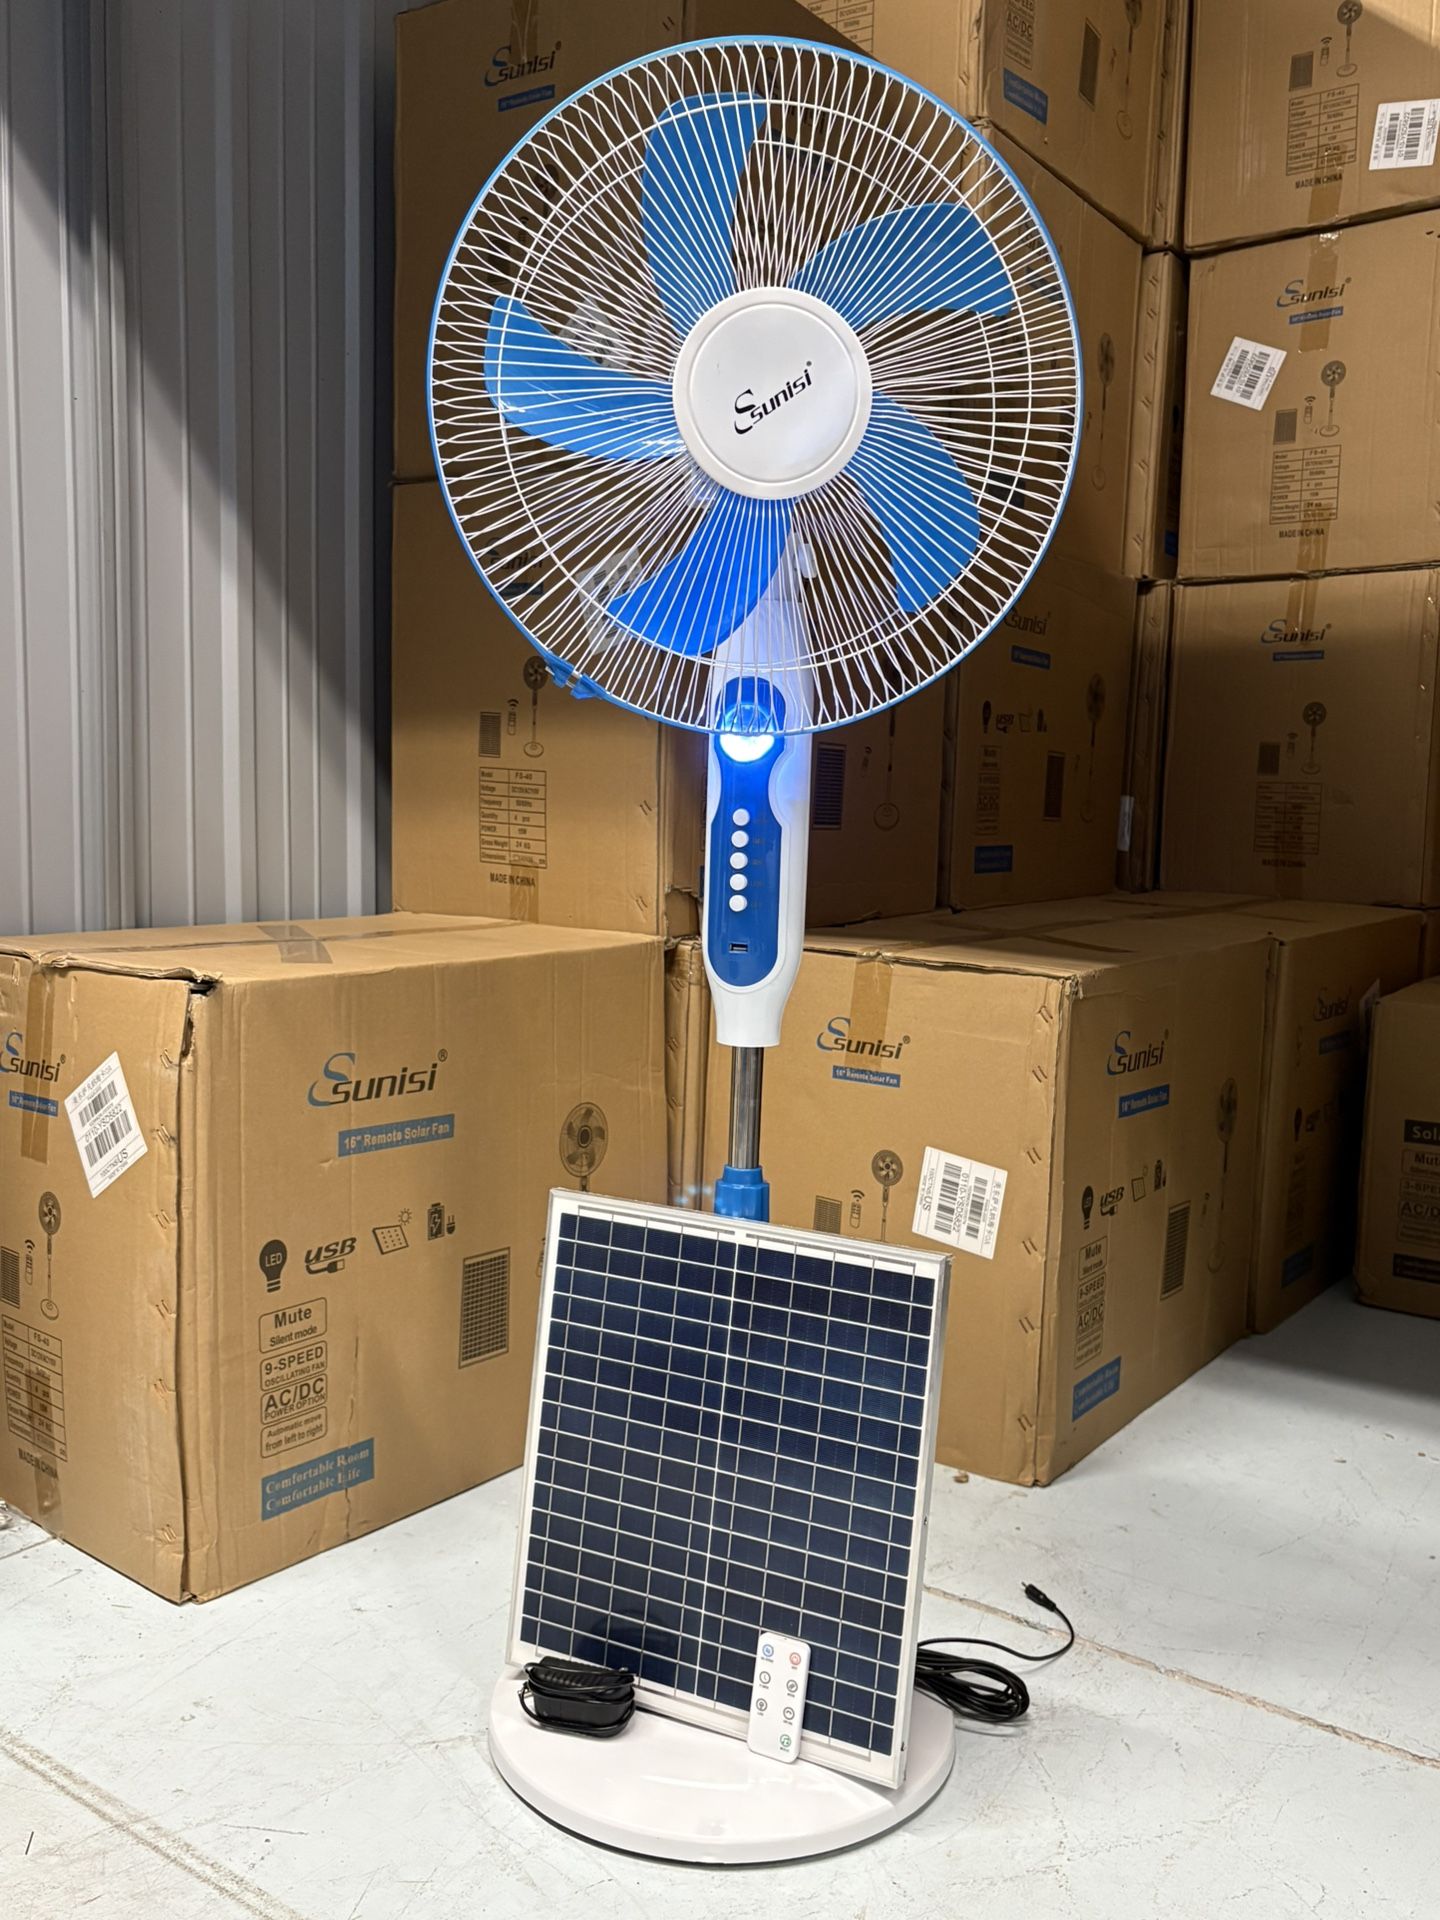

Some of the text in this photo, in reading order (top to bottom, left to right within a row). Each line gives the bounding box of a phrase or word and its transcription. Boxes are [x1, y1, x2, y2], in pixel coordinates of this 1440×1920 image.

[734, 368, 812, 435] Sunisi
[489, 871, 507, 885] MADE
[515, 876, 536, 888] CHINA
[816, 1016, 903, 1060] Sunisi
[1107, 1030, 1165, 1076] Sunisi
[308, 1052, 438, 1107] Sunisi
[364, 1131, 402, 1147] Remote
[404, 1127, 430, 1139] Solar
[432, 1122, 449, 1135] Fan
[1412, 1125, 1440, 1140] Sol
[1100, 1186, 1125, 1208] USB
[265, 1252, 283, 1267] LED
[304, 1237, 357, 1265] USB
[274, 1307, 312, 1329] Mute
[270, 1325, 318, 1347] Silent mode
[264, 1361, 325, 1388] OSCILLATING FAN
[265, 1346, 323, 1376] 9-SPEED
[264, 1393, 326, 1421] POWER OPTION
[265, 1377, 324, 1412] AC/DC
[265, 1424, 323, 1452] from left to right
[267, 1420, 303, 1438] Automatic
[265, 1449, 369, 1494] Comfortable Room
